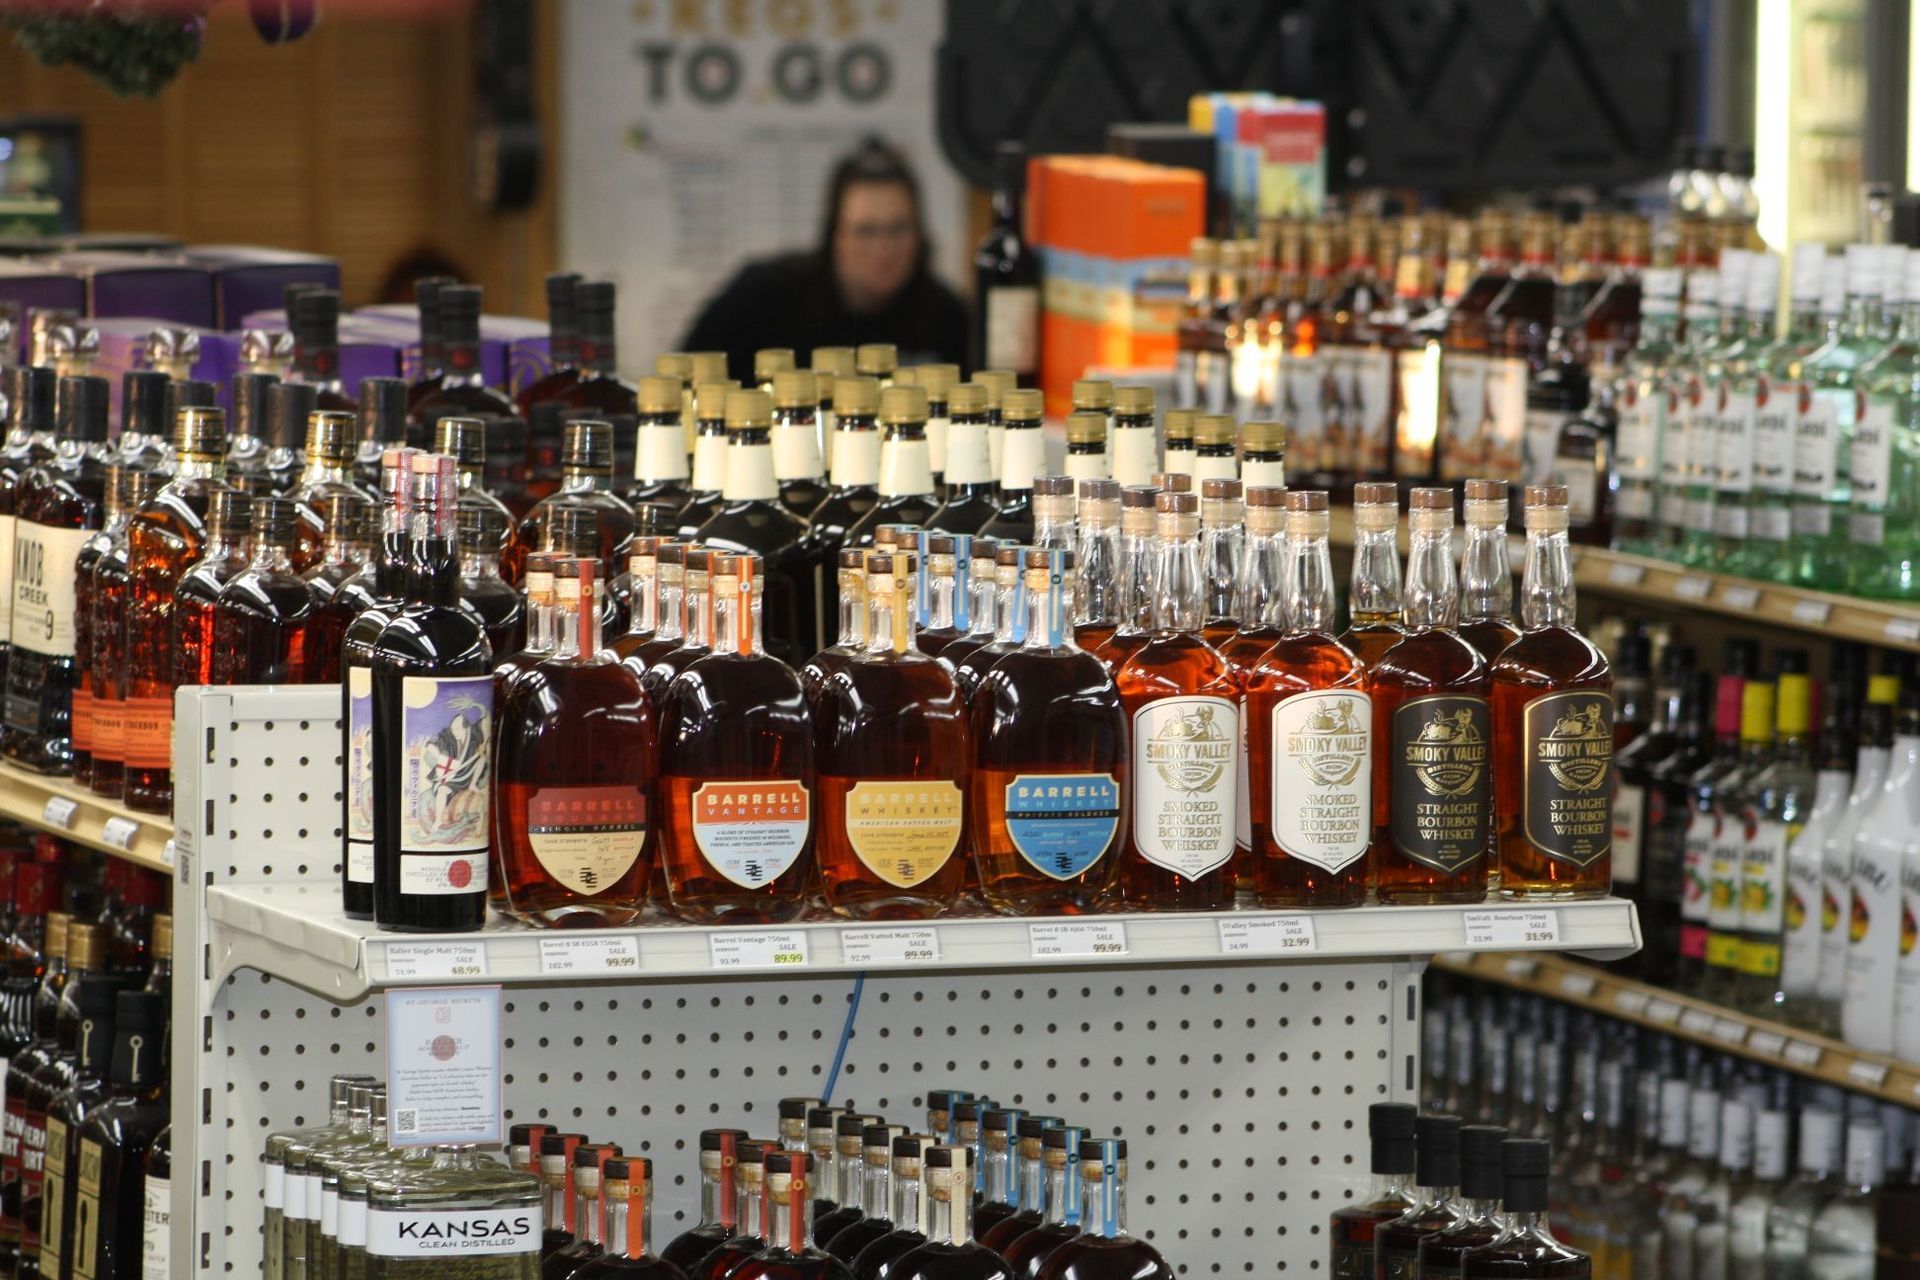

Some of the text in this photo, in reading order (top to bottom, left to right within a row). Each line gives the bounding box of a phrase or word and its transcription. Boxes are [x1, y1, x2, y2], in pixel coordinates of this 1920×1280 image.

[638, 42, 893, 106] TO GO
[19, 585, 49, 606] CREEK
[45, 610, 54, 641] 9
[1288, 735, 1367, 752] SMOKY VALLEY
[1538, 742, 1582, 757] SMOKY
[1146, 743, 1232, 758] SMOKY VALLEY
[1406, 746, 1449, 761] SMOKY
[1018, 786, 1110, 798] BARRELL
[707, 793, 801, 806] BARRELL
[860, 793, 953, 804] BARRELL
[1018, 799, 1111, 808] WHISKEY
[1305, 793, 1357, 805] SMOKED
[1550, 797, 1607, 810] STRAIGHT
[541, 800, 635, 813] BARRELL
[707, 806, 801, 816] VANTAGE
[860, 806, 953, 815] WHISKEY
[1163, 801, 1218, 812] SMOKED
[1300, 806, 1360, 818] STRAIGHT
[1416, 802, 1479, 815] STRAIGHT
[1158, 814, 1222, 825] STRAIGHT
[1416, 815, 1479, 828] BOURBON
[1550, 810, 1607, 823] BOURBON
[1300, 819, 1360, 831] BOURBON
[1553, 823, 1605, 836] WHISKEY
[1158, 826, 1222, 838] BOURBON
[1304, 832, 1358, 844] WHISKEY
[1420, 828, 1477, 840] WHISKEY
[1162, 839, 1219, 851] WHISKEY
[1281, 938, 1310, 947] 32.99
[1525, 932, 1553, 941] 31.99
[1093, 944, 1122, 953] 99.99
[774, 953, 803, 963] 89.99
[904, 950, 933, 960] 89.99
[606, 957, 635, 967] 99.99
[451, 966, 481, 975] 48.99
[398, 1217, 531, 1239] KANSAS
[419, 1238, 516, 1249] CLEAN DISTILLED
